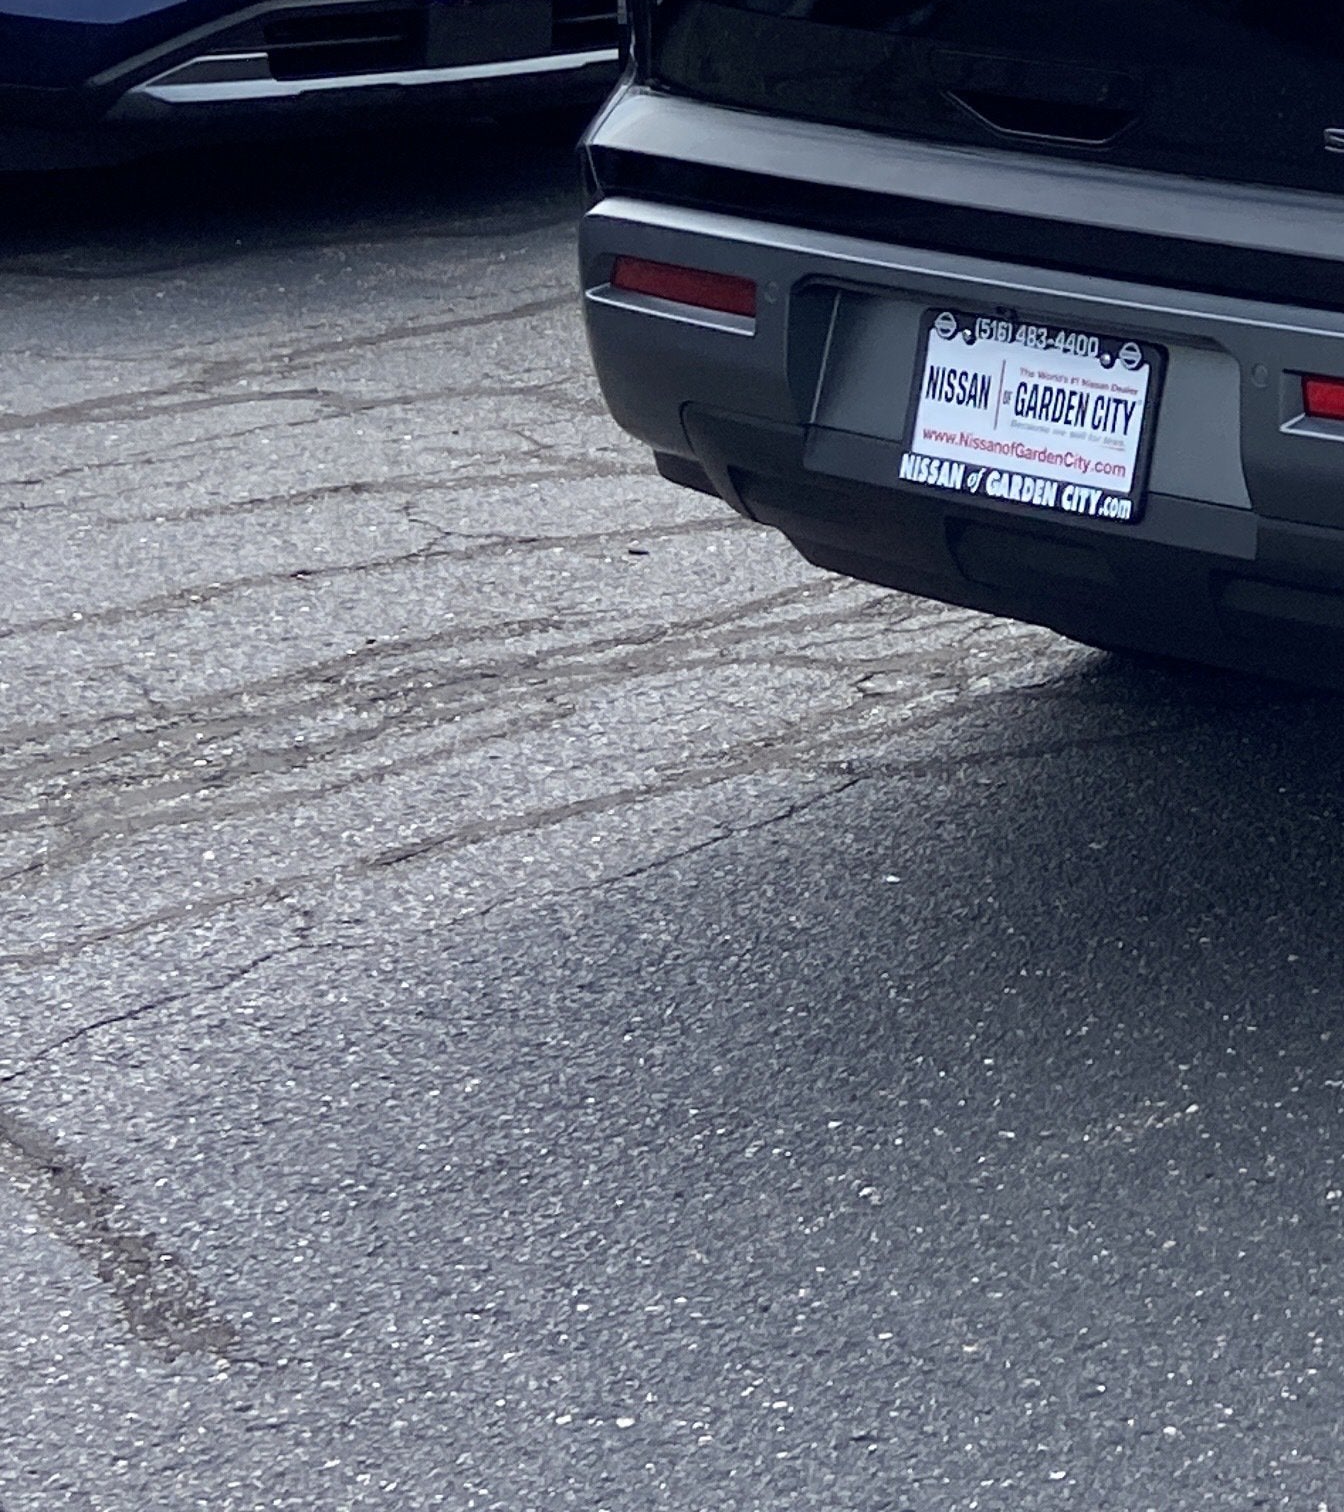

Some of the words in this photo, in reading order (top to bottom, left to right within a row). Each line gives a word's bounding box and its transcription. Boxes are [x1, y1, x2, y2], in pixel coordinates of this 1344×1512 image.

[975, 318, 1013, 343] (516)
[1016, 325, 1099, 359] 483-4400
[925, 365, 992, 410] NISSAN
[1014, 381, 1090, 428] GARDEN
[1091, 395, 1137, 436] CITY
[923, 428, 1126, 478] www.NissanofGardenCity.com
[899, 453, 965, 490] NISSAN
[966, 467, 986, 493] of
[985, 470, 1058, 508] GARDEN
[1061, 485, 1132, 520] CITY.com
